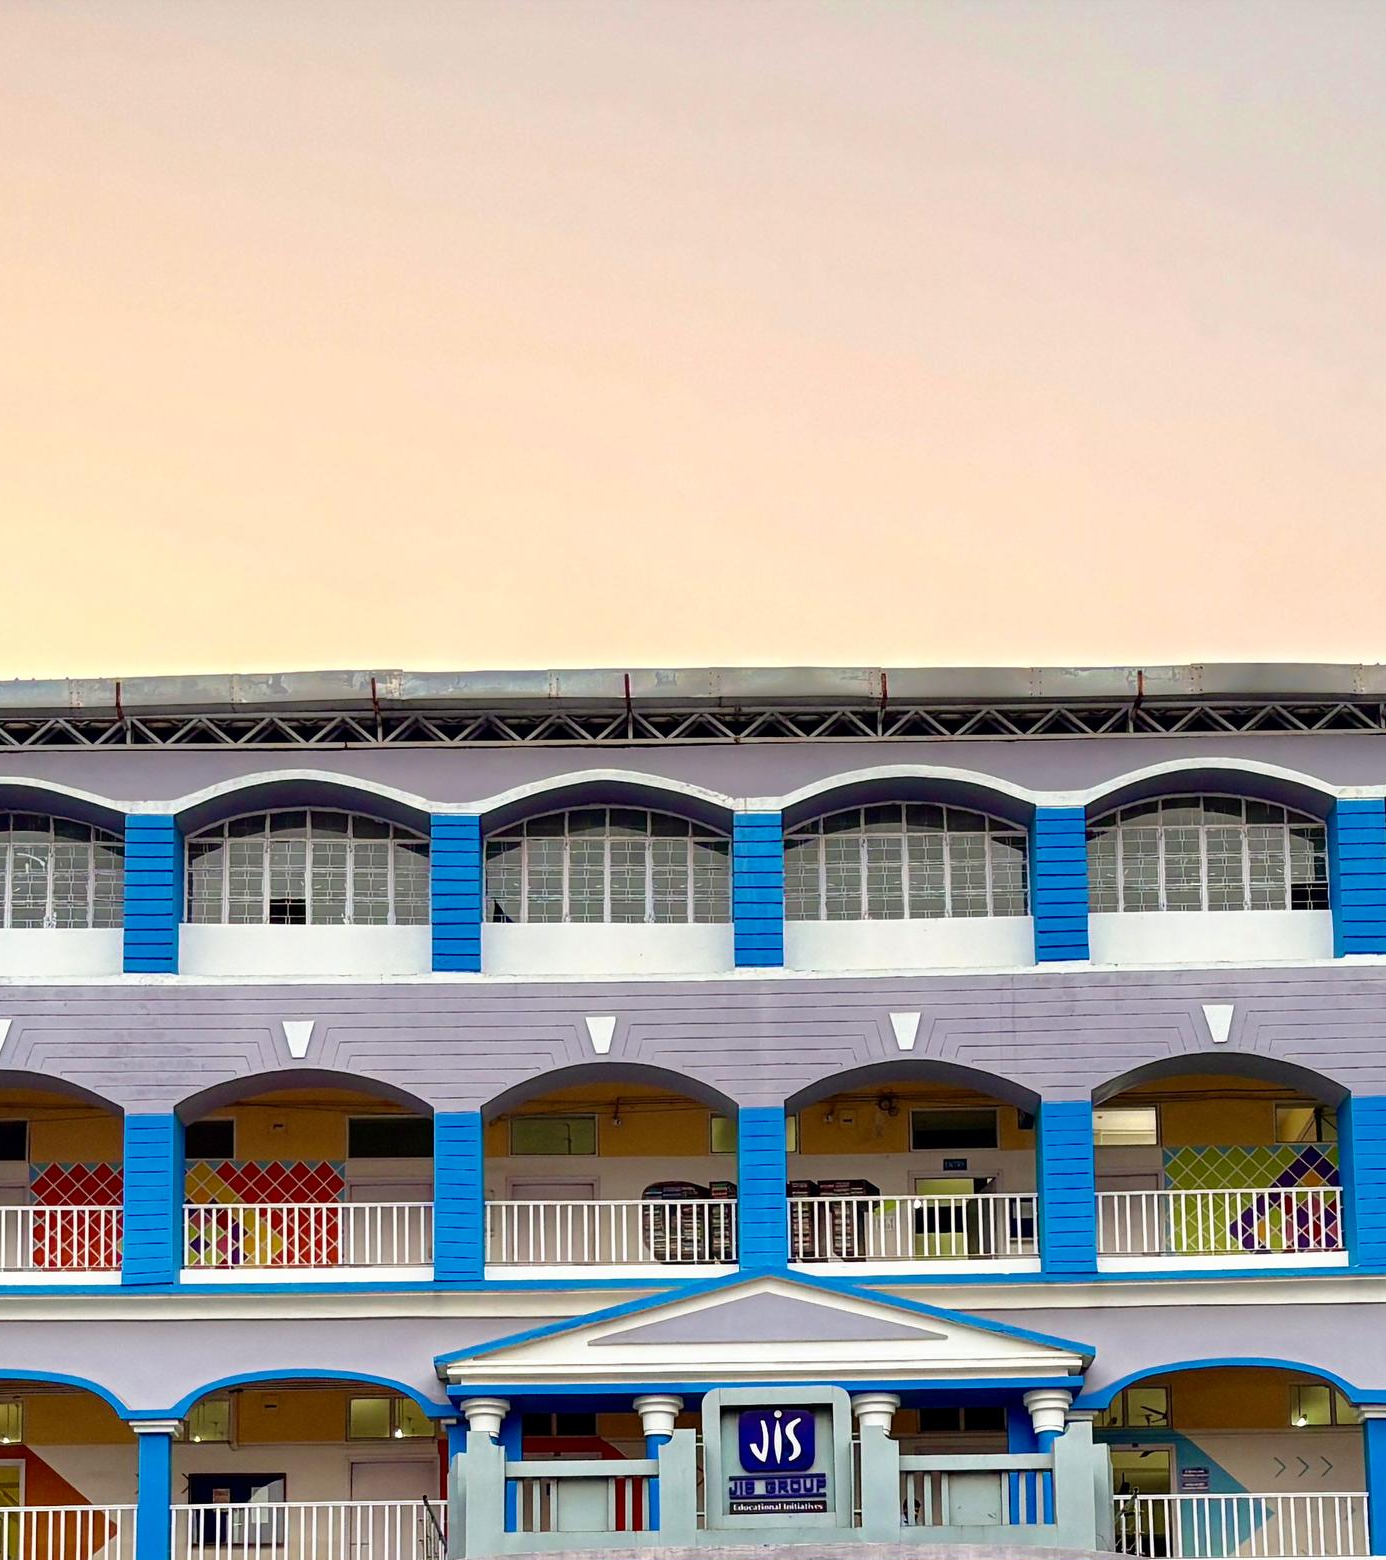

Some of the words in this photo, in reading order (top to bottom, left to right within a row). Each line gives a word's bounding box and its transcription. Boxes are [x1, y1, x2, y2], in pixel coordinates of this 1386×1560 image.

[765, 1478, 827, 1494] GROUP
[733, 1503, 781, 1511] Educational
[783, 1502, 823, 1511] Initiatives
